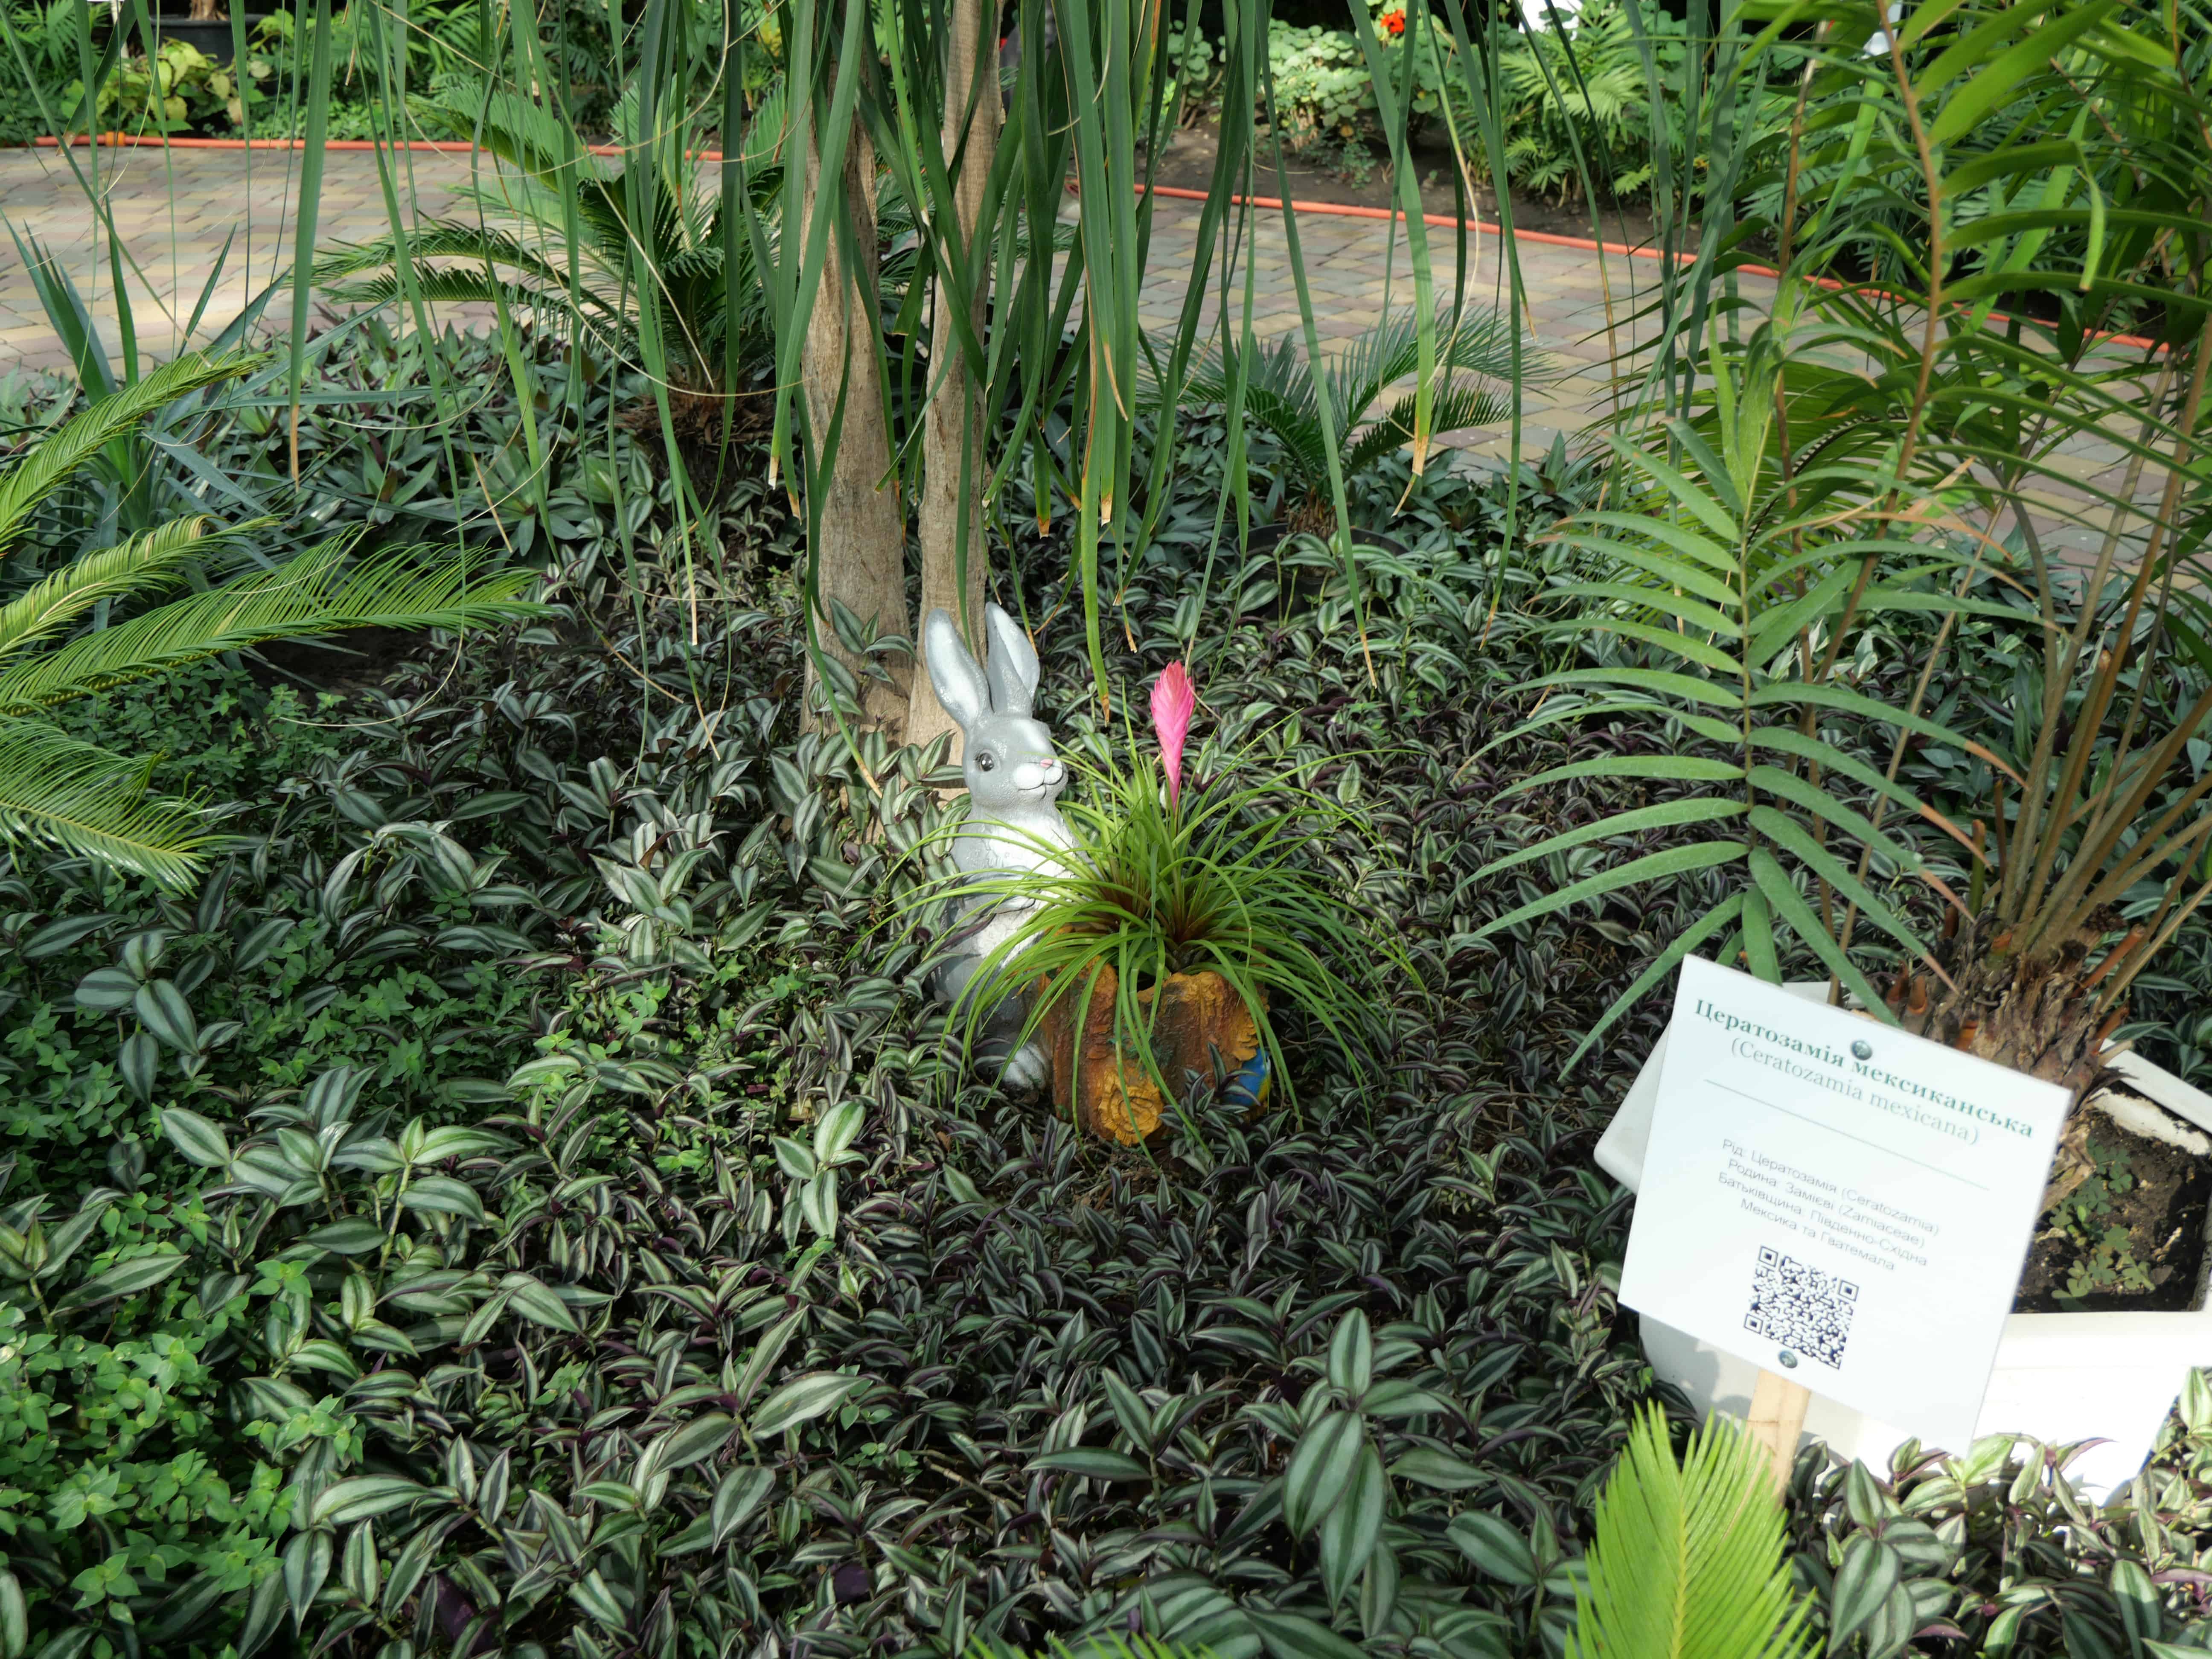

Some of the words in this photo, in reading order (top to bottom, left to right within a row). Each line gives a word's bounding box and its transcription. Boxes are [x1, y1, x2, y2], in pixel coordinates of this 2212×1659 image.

[1694, 999, 1844, 1068] Цератозамія
[1851, 1061, 2032, 1138] мексиканська
[1732, 1038, 1863, 1101] (Ceratozamia
[1869, 1093, 1979, 1144] mexicana)
[1751, 1150, 1837, 1193] Цератозамія
[1841, 1188, 1939, 1236] (Ceratozamia)
[1786, 1182, 1834, 1210] Замієві
[1839, 1205, 1925, 1249] (Zamiaceae)
[1741, 1198, 1797, 1230] Мексика
[1802, 1226, 1816, 1238] та
[1820, 1231, 1894, 1270] Гватемала
[1810, 1210, 1927, 1266] Південно-Східна
